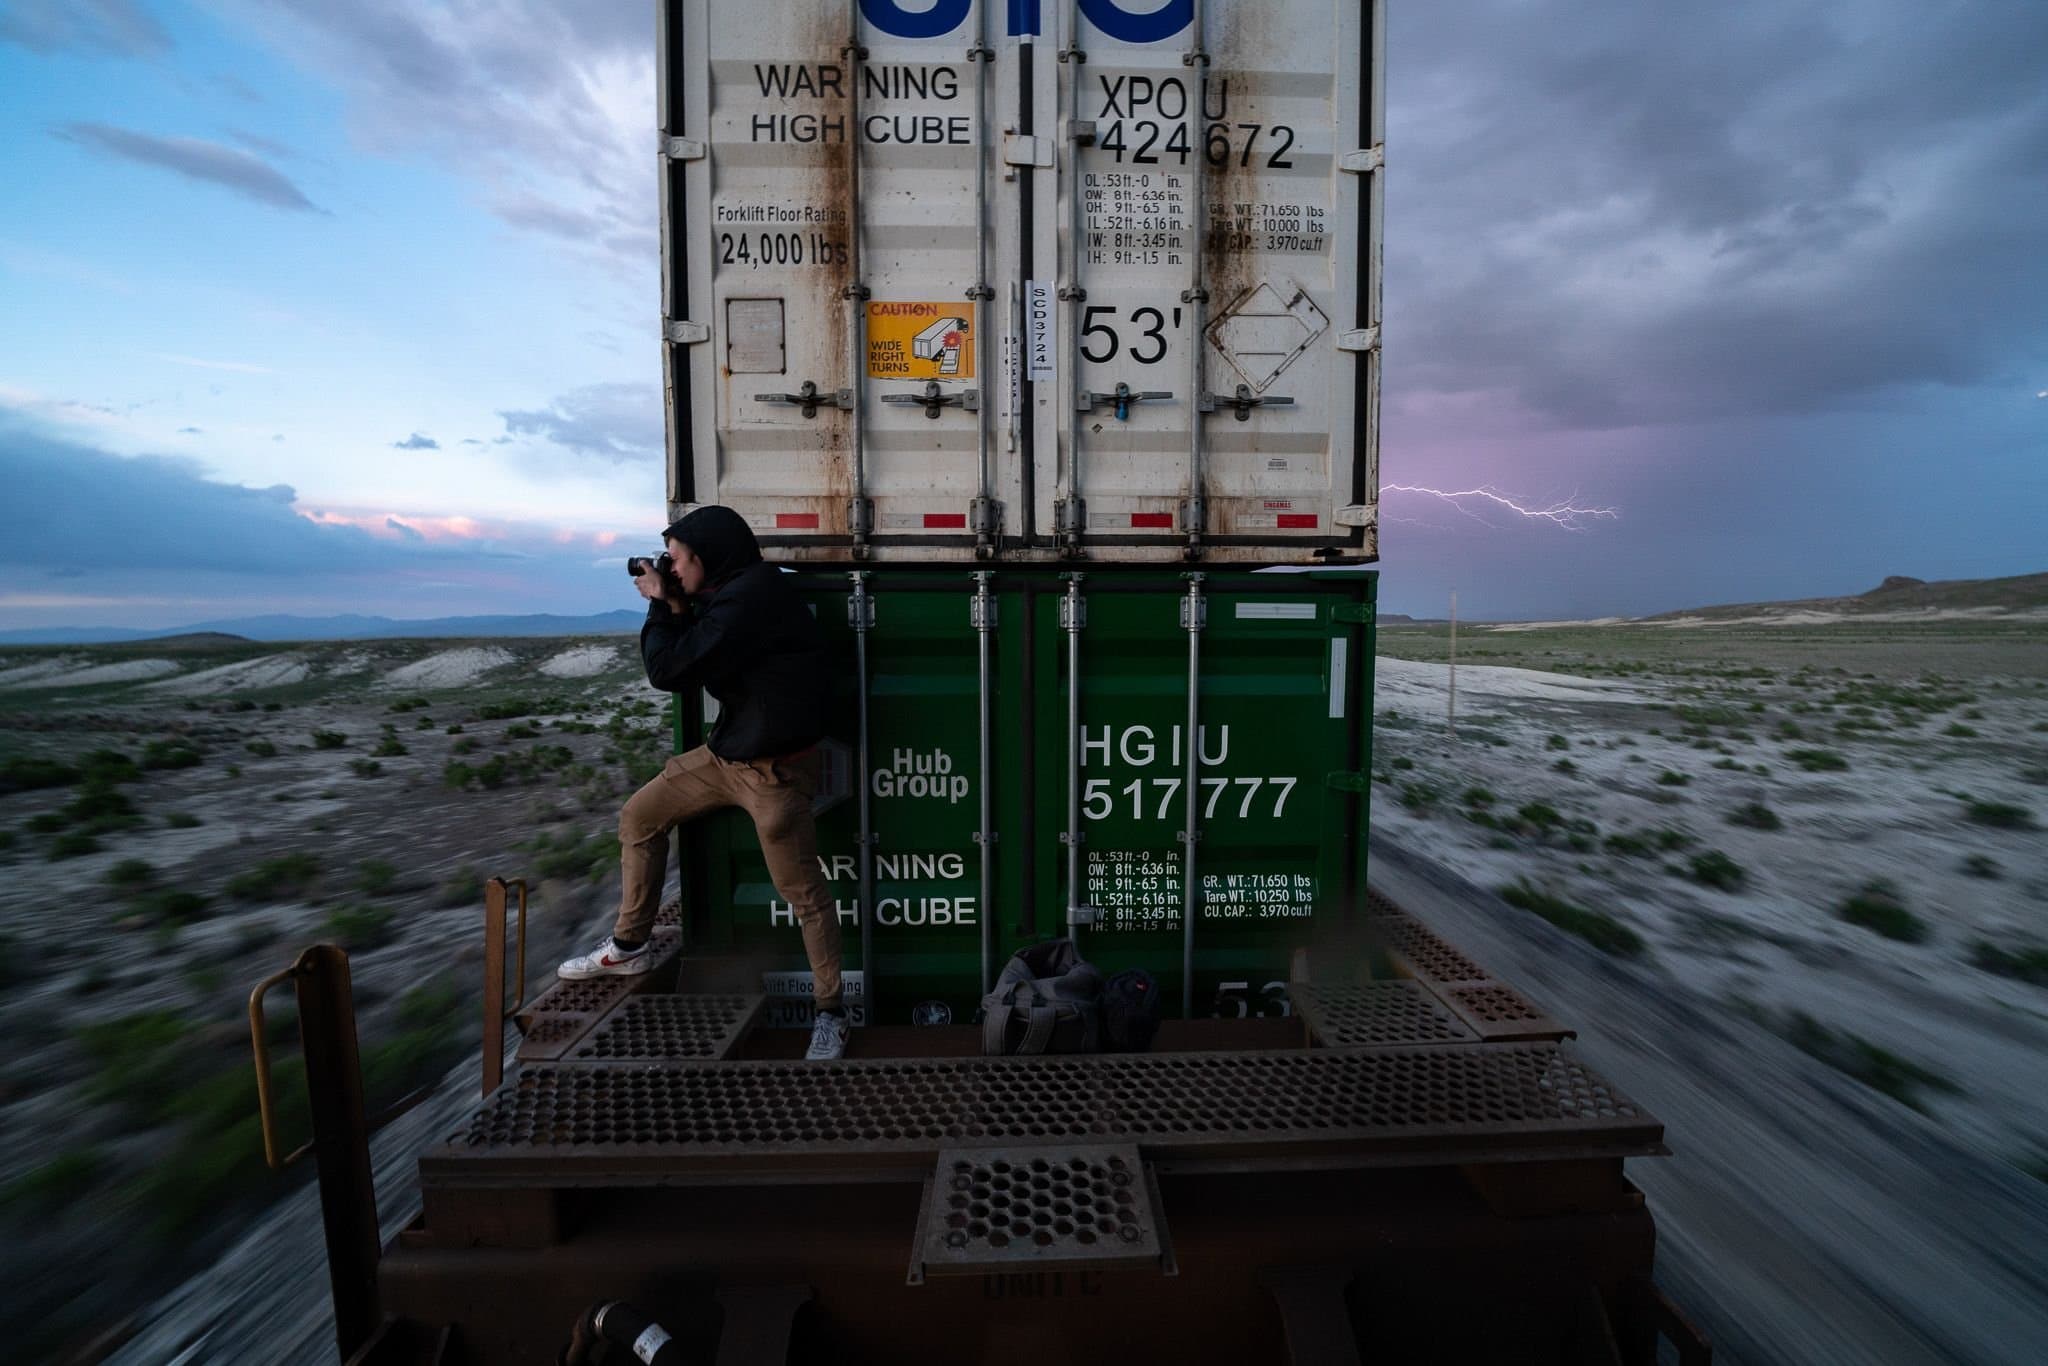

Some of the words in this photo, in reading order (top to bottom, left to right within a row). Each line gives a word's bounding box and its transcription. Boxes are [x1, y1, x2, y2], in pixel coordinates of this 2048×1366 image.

[751, 114, 846, 144] HIGH
[864, 116, 971, 145] CUBE
[1167, 175, 1182, 188] in.
[1168, 191, 1183, 201] in.
[1169, 203, 1184, 214] in.
[1306, 205, 1324, 217] lbs
[717, 206, 764, 222] Forklift
[767, 206, 801, 222] Floor
[804, 206, 847, 226] Rating
[1169, 217, 1184, 230] in.
[1306, 219, 1324, 232] lbs
[1168, 234, 1183, 248] in.
[721, 232, 803, 270] 24,000
[811, 232, 848, 265] lbs
[1168, 251, 1183, 264] in.
[870, 303, 938, 316] CAUTION
[1033, 288, 1048, 363] SCD3724
[1079, 305, 1182, 364] 53'
[871, 340, 902, 351] WIDE
[870, 351, 906, 362] RIGHT
[871, 362, 909, 373] TURNS
[893, 747, 952, 775] Hub
[872, 768, 969, 804] Group
[1166, 850, 1180, 862] in.
[1088, 863, 1109, 876] OW:
[1166, 862, 1180, 876] in.
[1088, 877, 1109, 891] OH:
[1166, 877, 1181, 890] in.
[1203, 874, 1222, 888] GR.
[1293, 873, 1311, 888] lbs
[1166, 892, 1181, 906] in.
[1203, 889, 1227, 903] Tare
[1254, 889, 1290, 903] 10,250
[1295, 889, 1312, 902] lbs
[876, 896, 977, 927] CUBE
[1095, 907, 1109, 921] W:
[1167, 907, 1181, 920] in.
[1204, 904, 1222, 918] CU.
[1290, 904, 1312, 917] cu.ft
[1166, 921, 1181, 931] in.
[789, 977, 814, 993] Floo
[842, 978, 862, 996] ing
